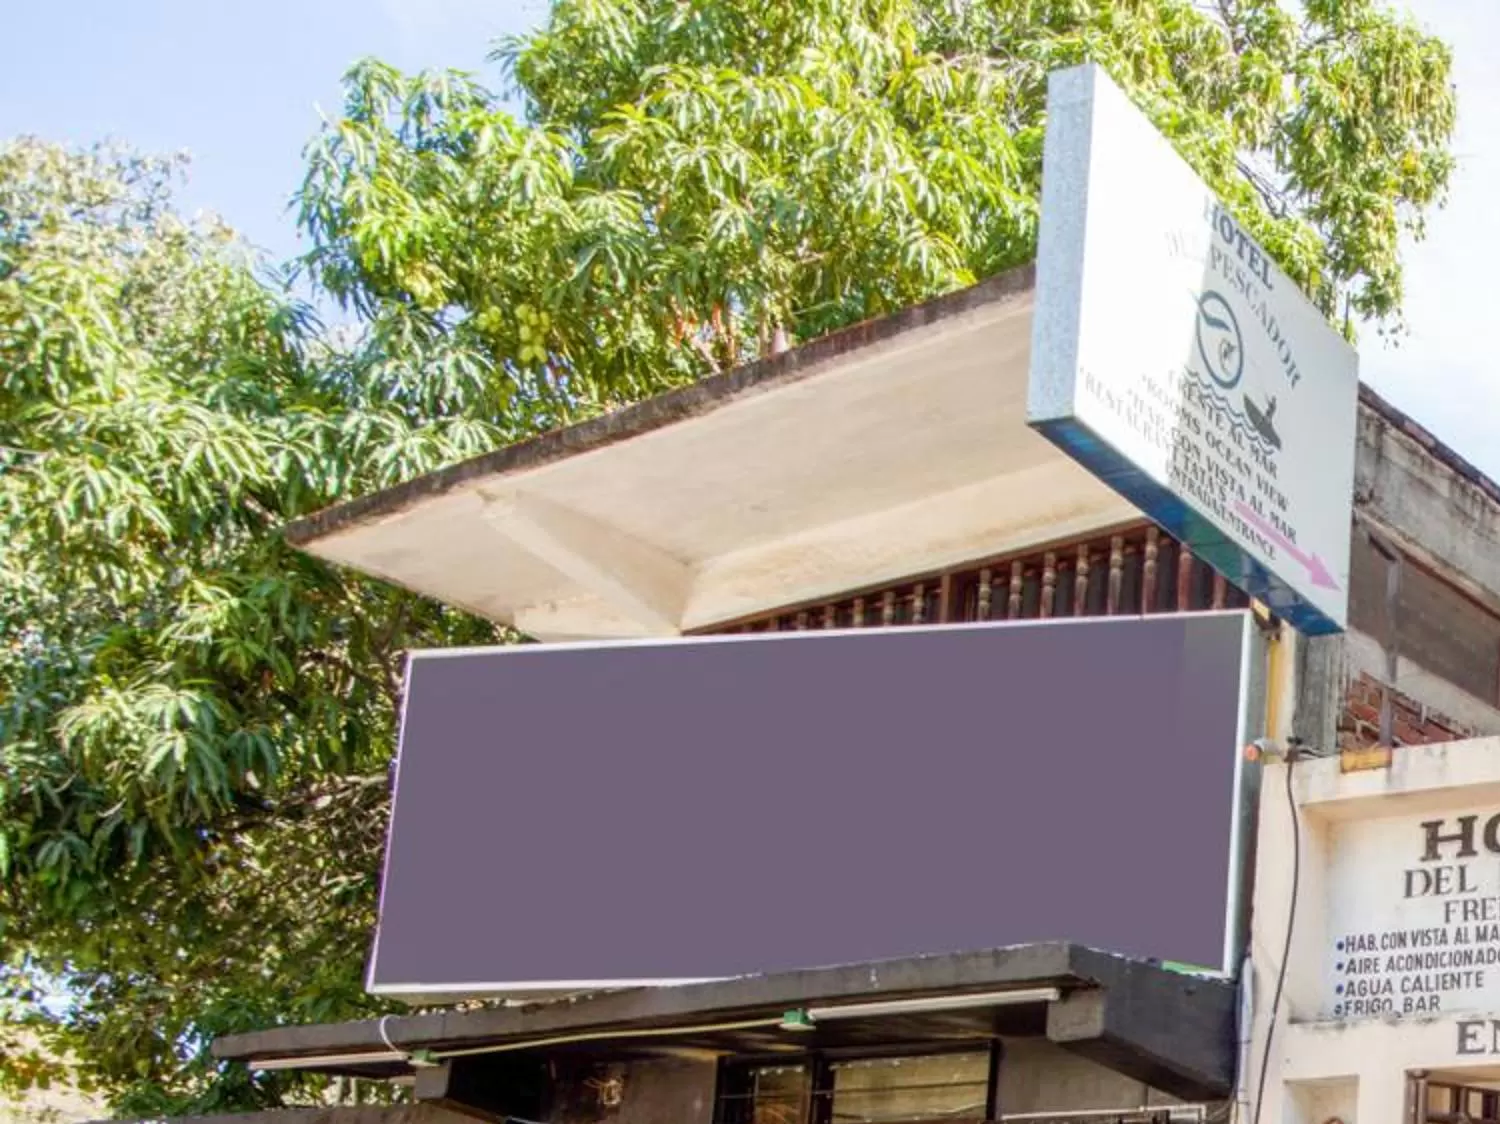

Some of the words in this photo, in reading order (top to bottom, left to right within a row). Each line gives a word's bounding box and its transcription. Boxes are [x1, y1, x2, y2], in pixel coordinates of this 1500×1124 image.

[1204, 195, 1274, 290] HOTEL
[1403, 863, 1479, 899] DEL
[1345, 934, 1379, 953] HAB.
[1381, 931, 1407, 950] CON
[1411, 927, 1449, 948] VISTA
[1453, 925, 1470, 945] AL
[1345, 957, 1381, 975] AIRE
[1344, 979, 1394, 998] AGUA
[1400, 971, 1485, 994] CALIENTE
[1402, 994, 1441, 1013] BAR
